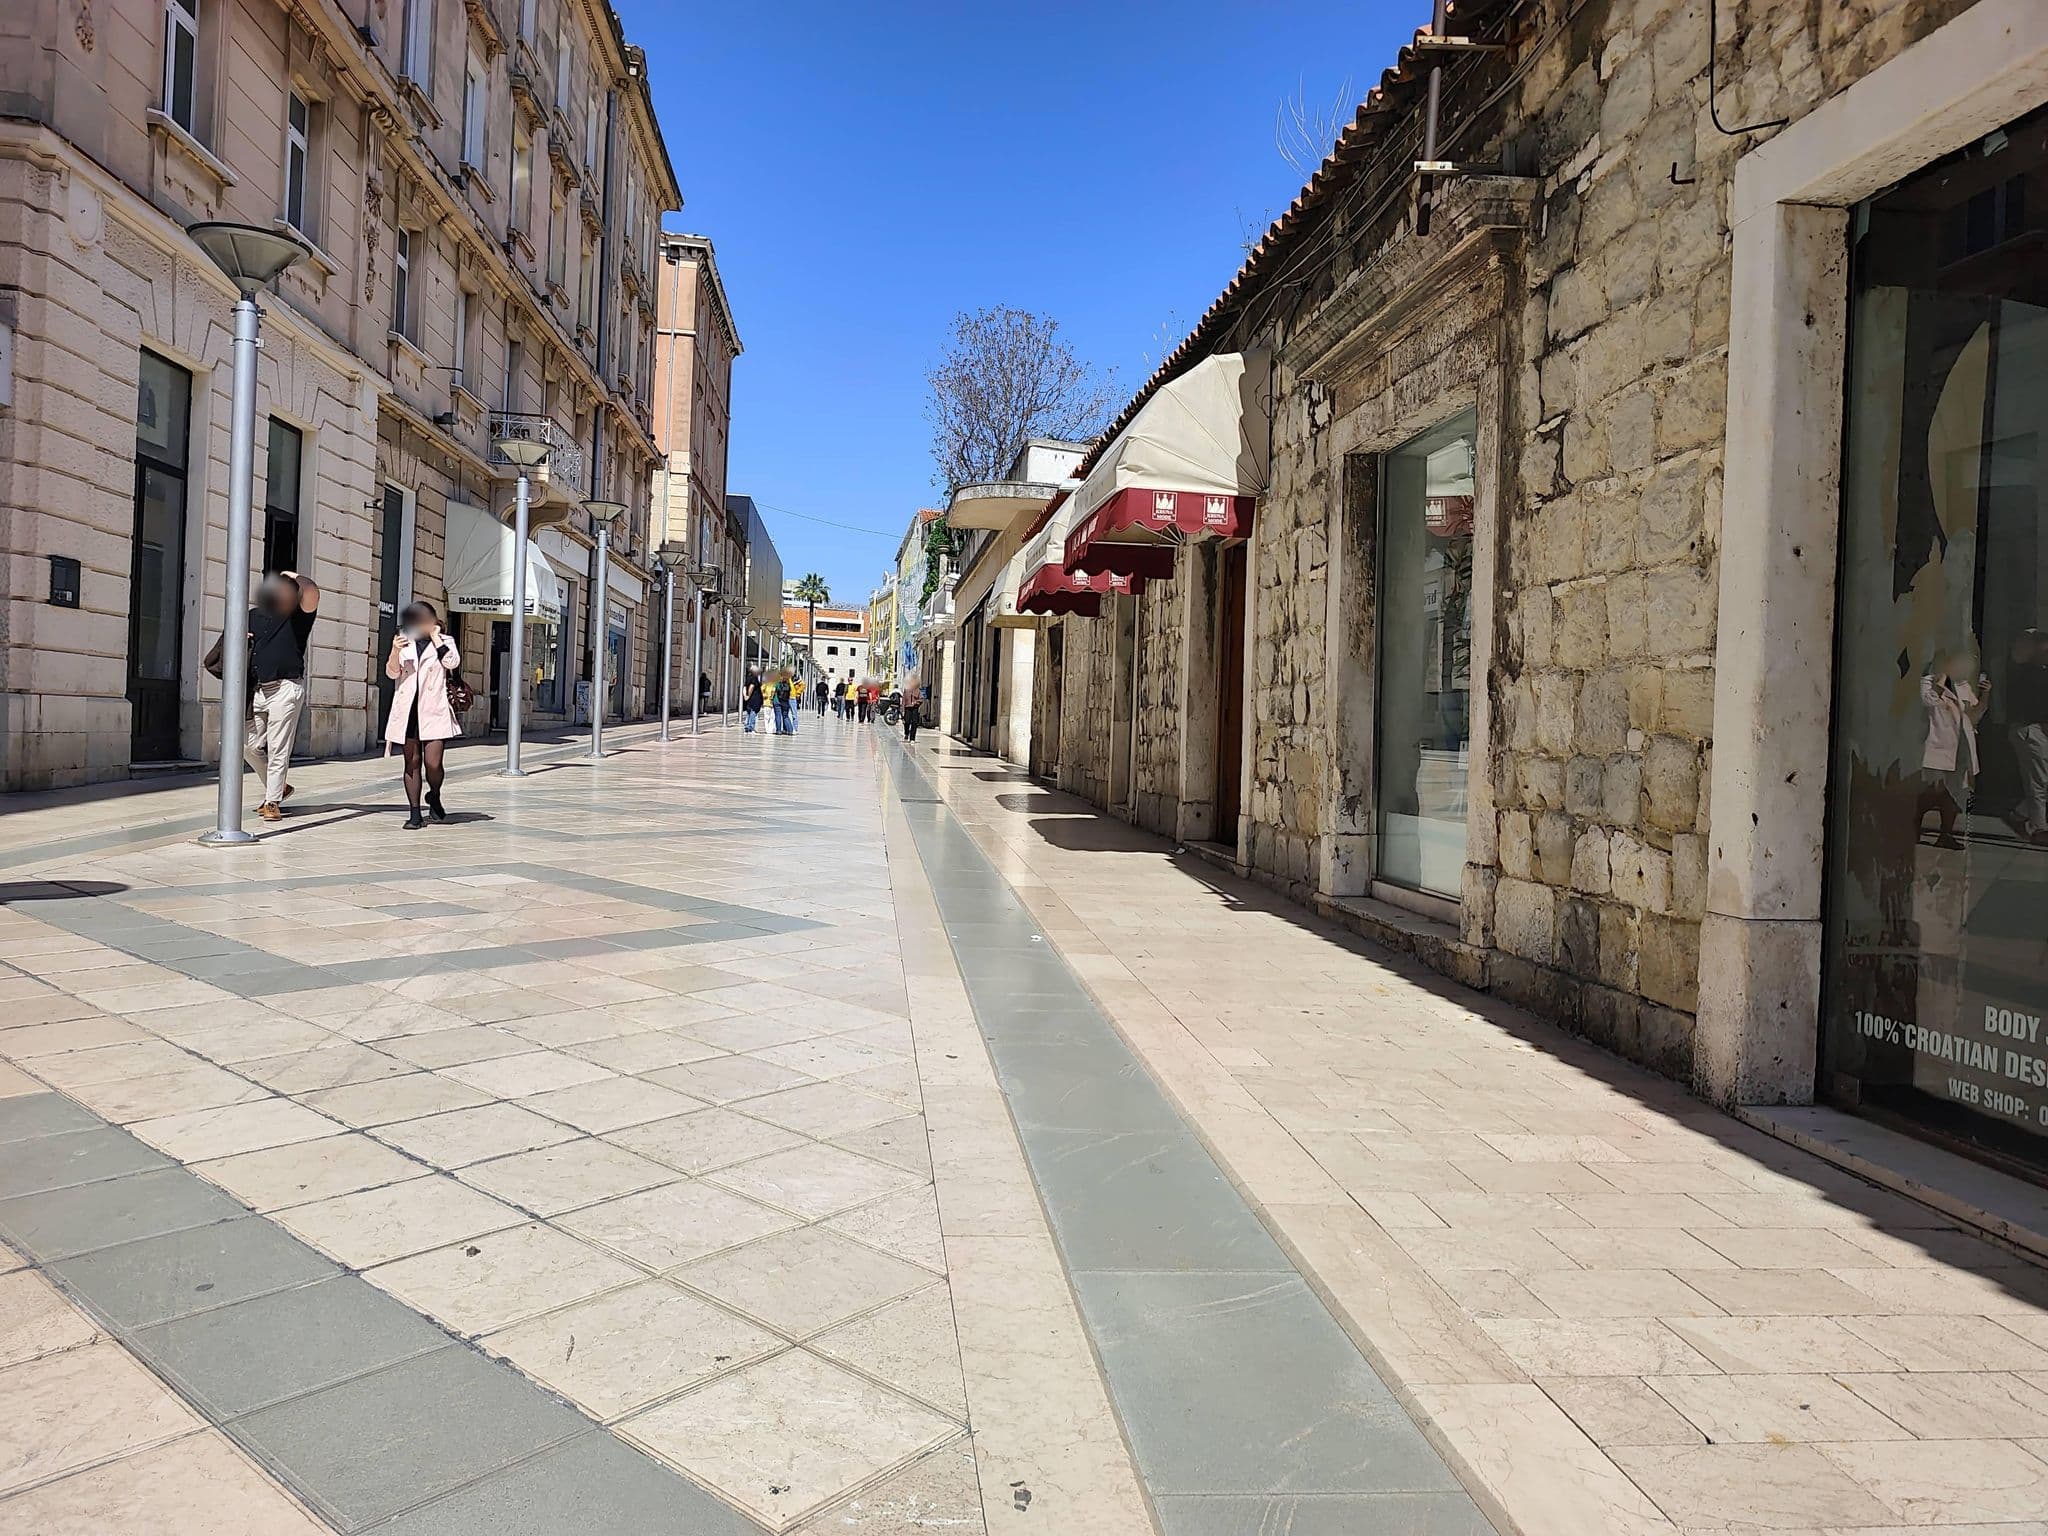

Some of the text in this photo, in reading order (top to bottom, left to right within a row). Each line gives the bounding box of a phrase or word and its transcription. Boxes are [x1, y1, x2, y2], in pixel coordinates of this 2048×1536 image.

[1984, 1004, 2041, 1044] BODY
[1854, 1010, 2048, 1089] 100% CROATIAN DES
[1948, 1077, 1980, 1105] WEB
[1983, 1088, 2030, 1120] SHOP:
